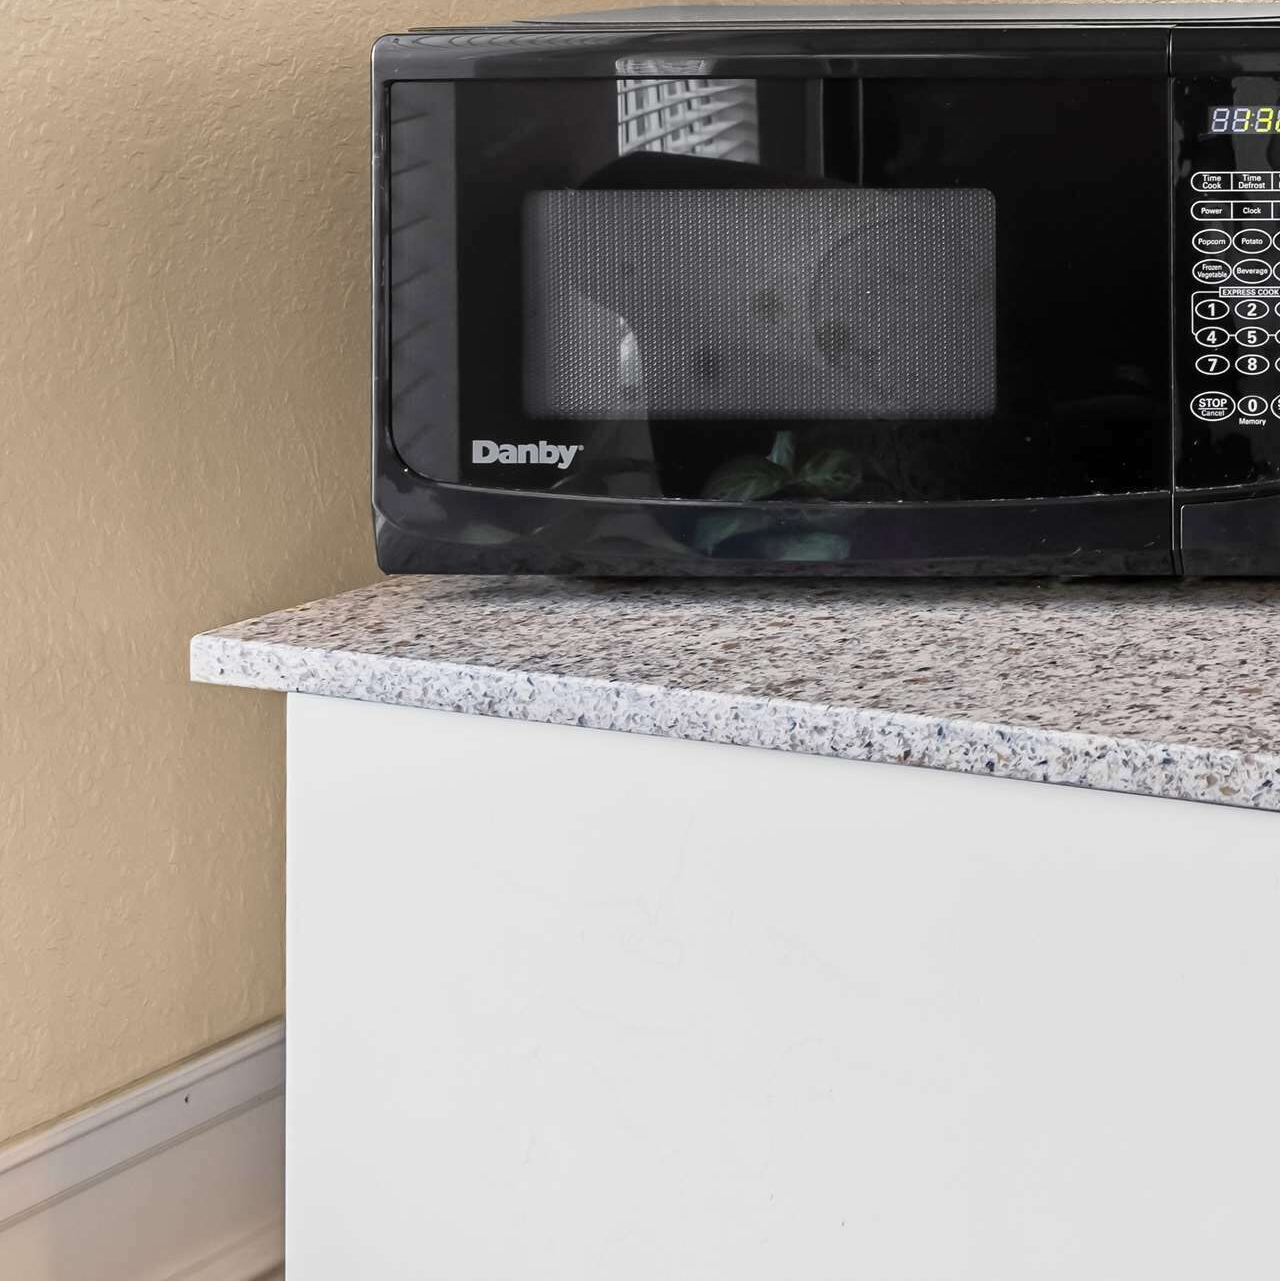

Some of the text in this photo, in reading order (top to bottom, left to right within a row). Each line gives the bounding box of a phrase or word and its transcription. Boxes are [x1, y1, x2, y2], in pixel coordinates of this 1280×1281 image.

[1198, 238, 1226, 246] Popcorn
[1236, 267, 1267, 275] Beverage
[1208, 303, 1215, 316] 1
[1247, 303, 1257, 316] 2
[1206, 330, 1217, 344] 4
[1247, 330, 1257, 344] 5
[1207, 358, 1218, 372] 7
[1247, 357, 1258, 371] 8
[1198, 398, 1228, 407] STOP
[1248, 399, 1258, 412] 0
[1239, 418, 1266, 426] Memory
[472, 440, 578, 469] Danby
